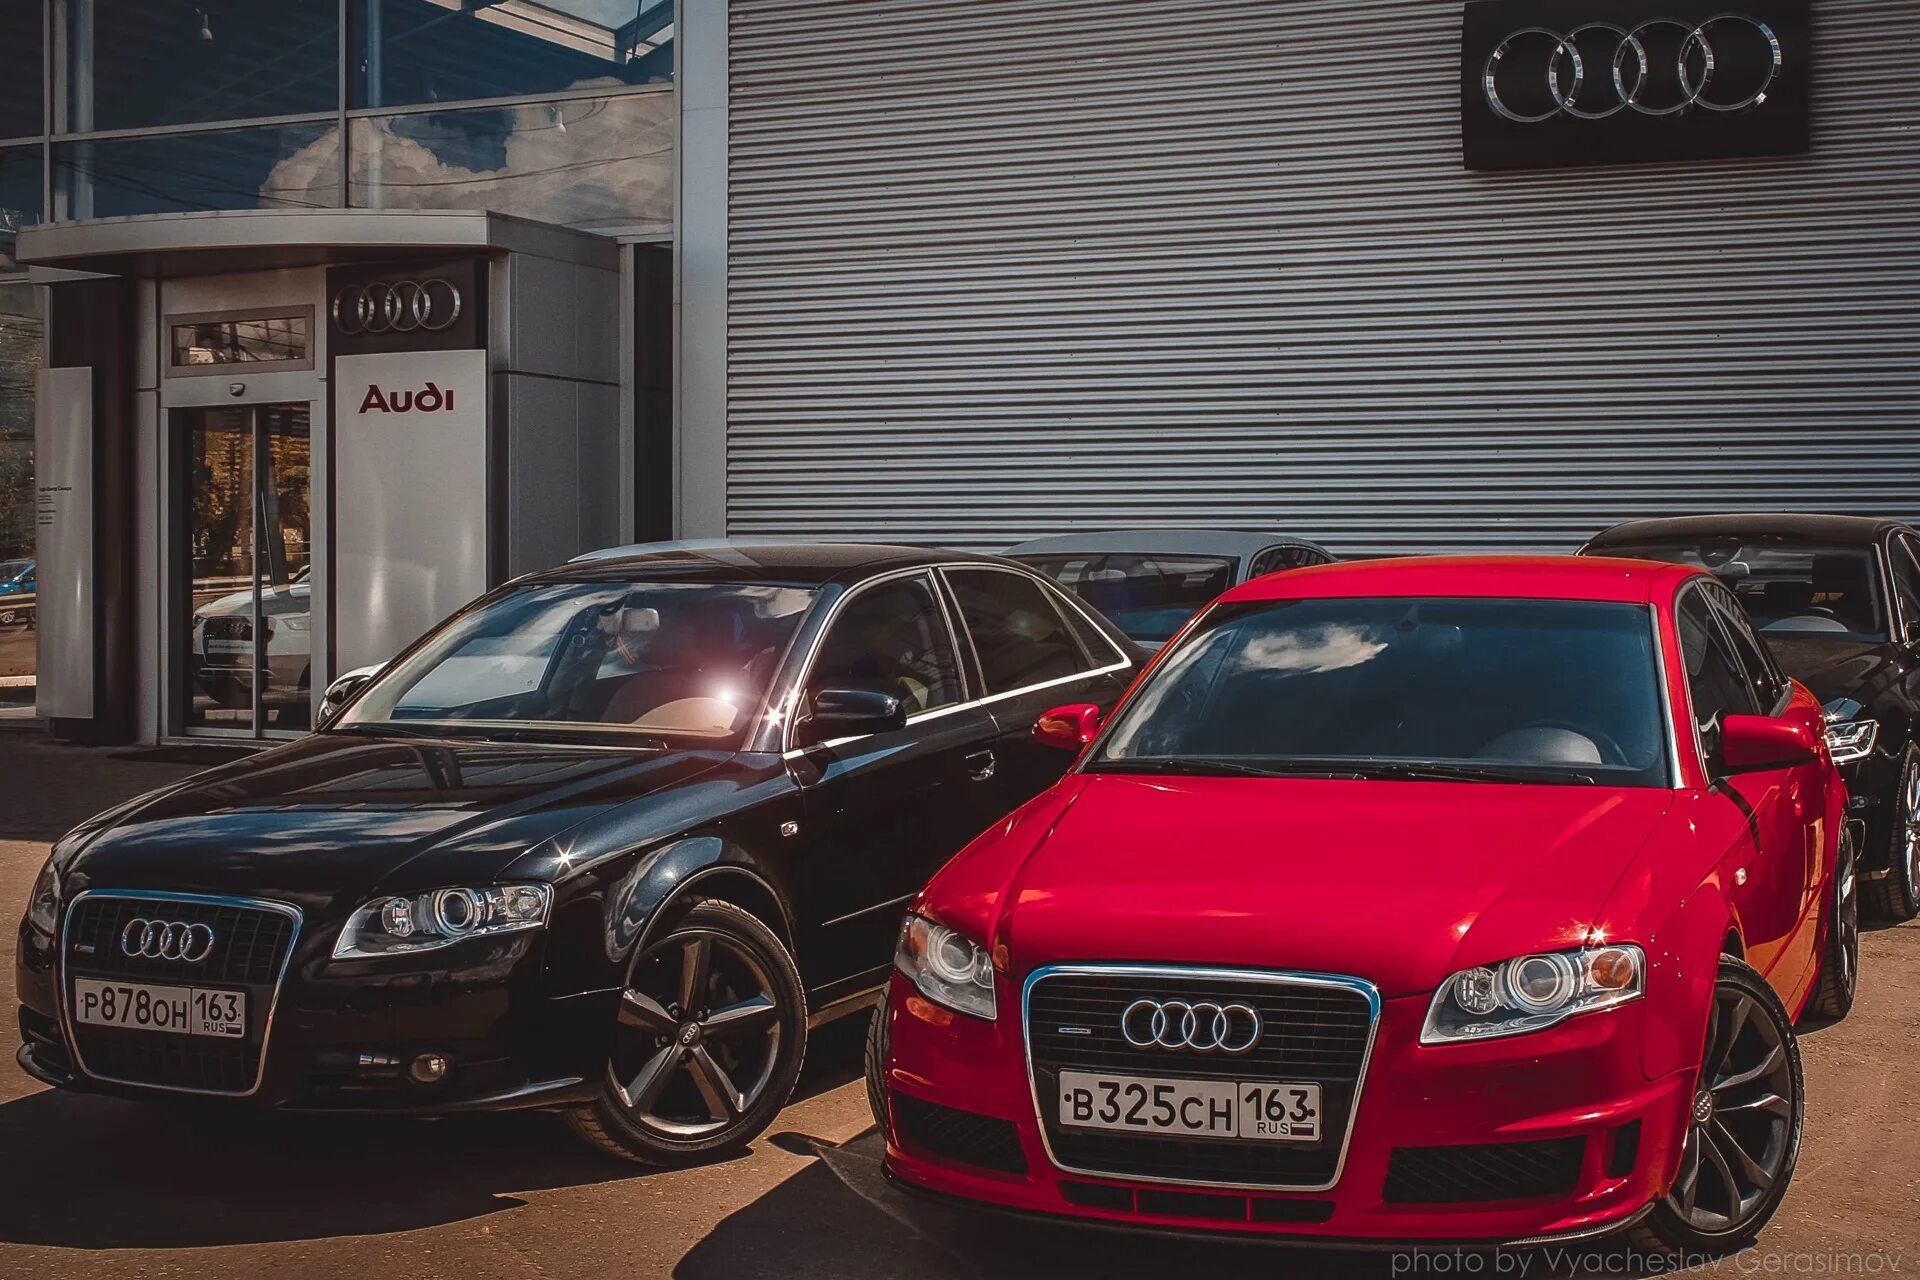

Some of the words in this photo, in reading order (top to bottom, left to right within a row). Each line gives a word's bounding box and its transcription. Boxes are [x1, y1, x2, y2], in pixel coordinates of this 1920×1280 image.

[358, 382, 454, 414] Audi
[194, 992, 238, 1022] 163
[203, 1021, 226, 1034] RUS
[1244, 1088, 1308, 1122] 163
[1257, 1121, 1289, 1135] RUS
